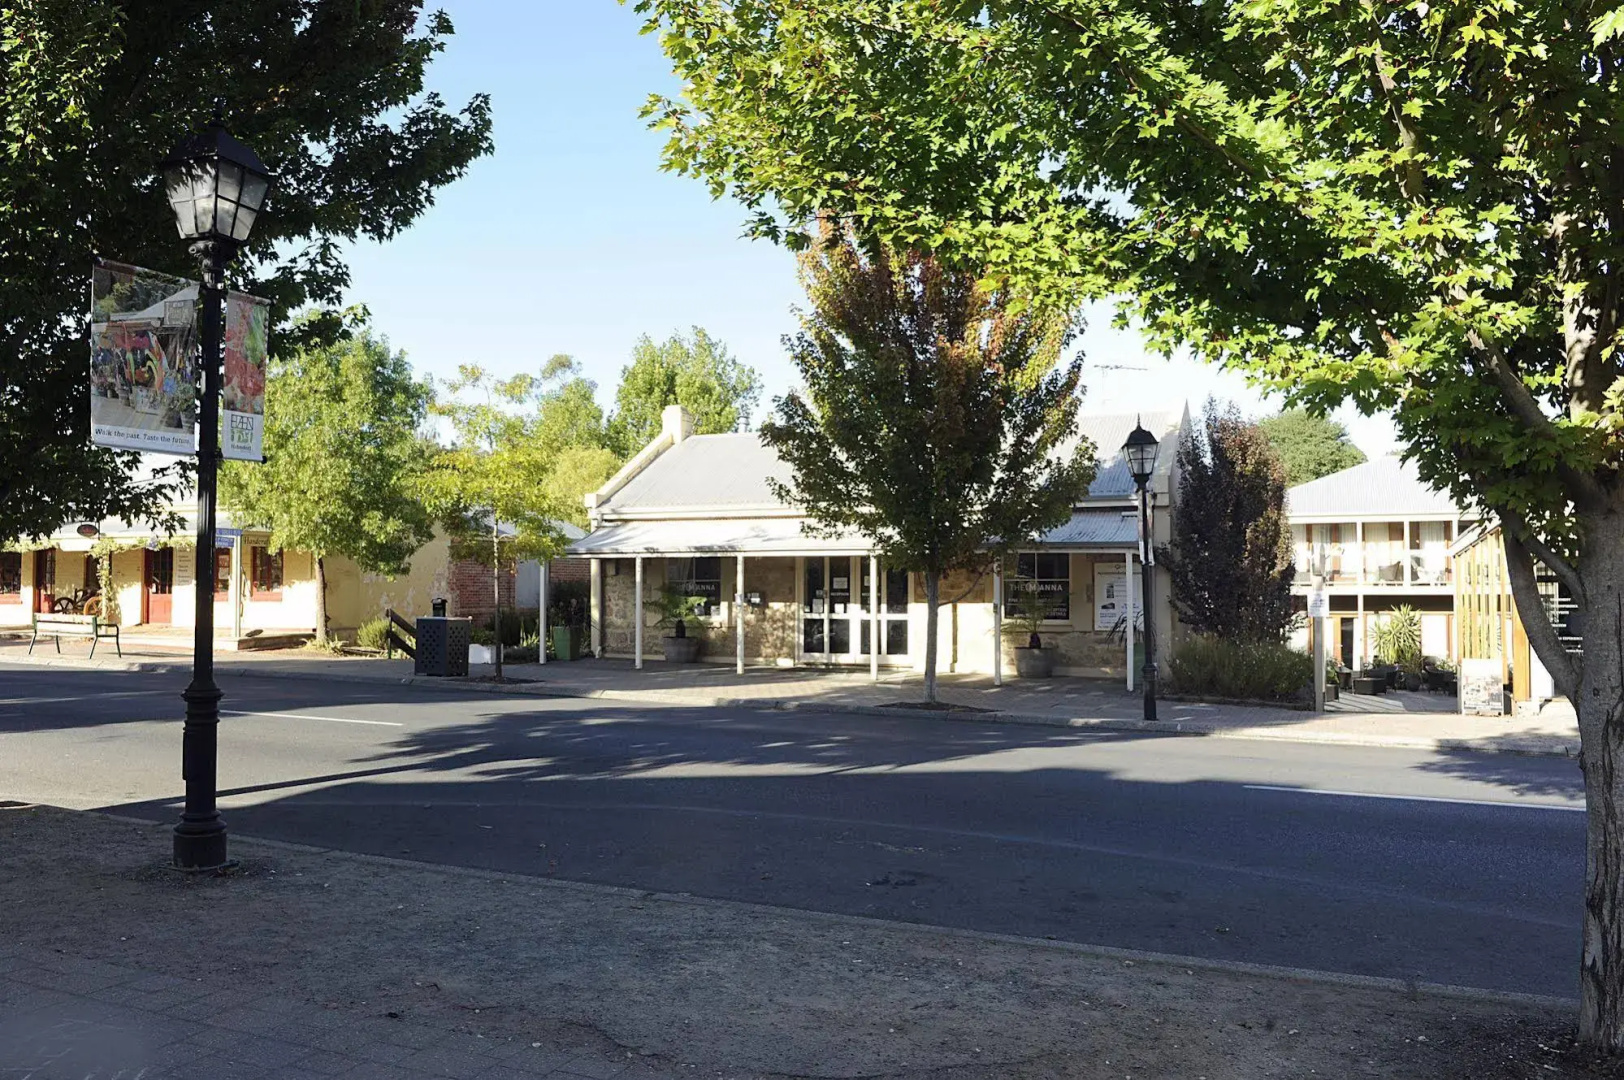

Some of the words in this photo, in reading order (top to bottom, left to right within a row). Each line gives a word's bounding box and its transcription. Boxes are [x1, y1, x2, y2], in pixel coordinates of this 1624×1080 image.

[95, 428, 112, 436] Walk
[114, 430, 125, 438] the
[1028, 583, 1063, 591] MANNA
